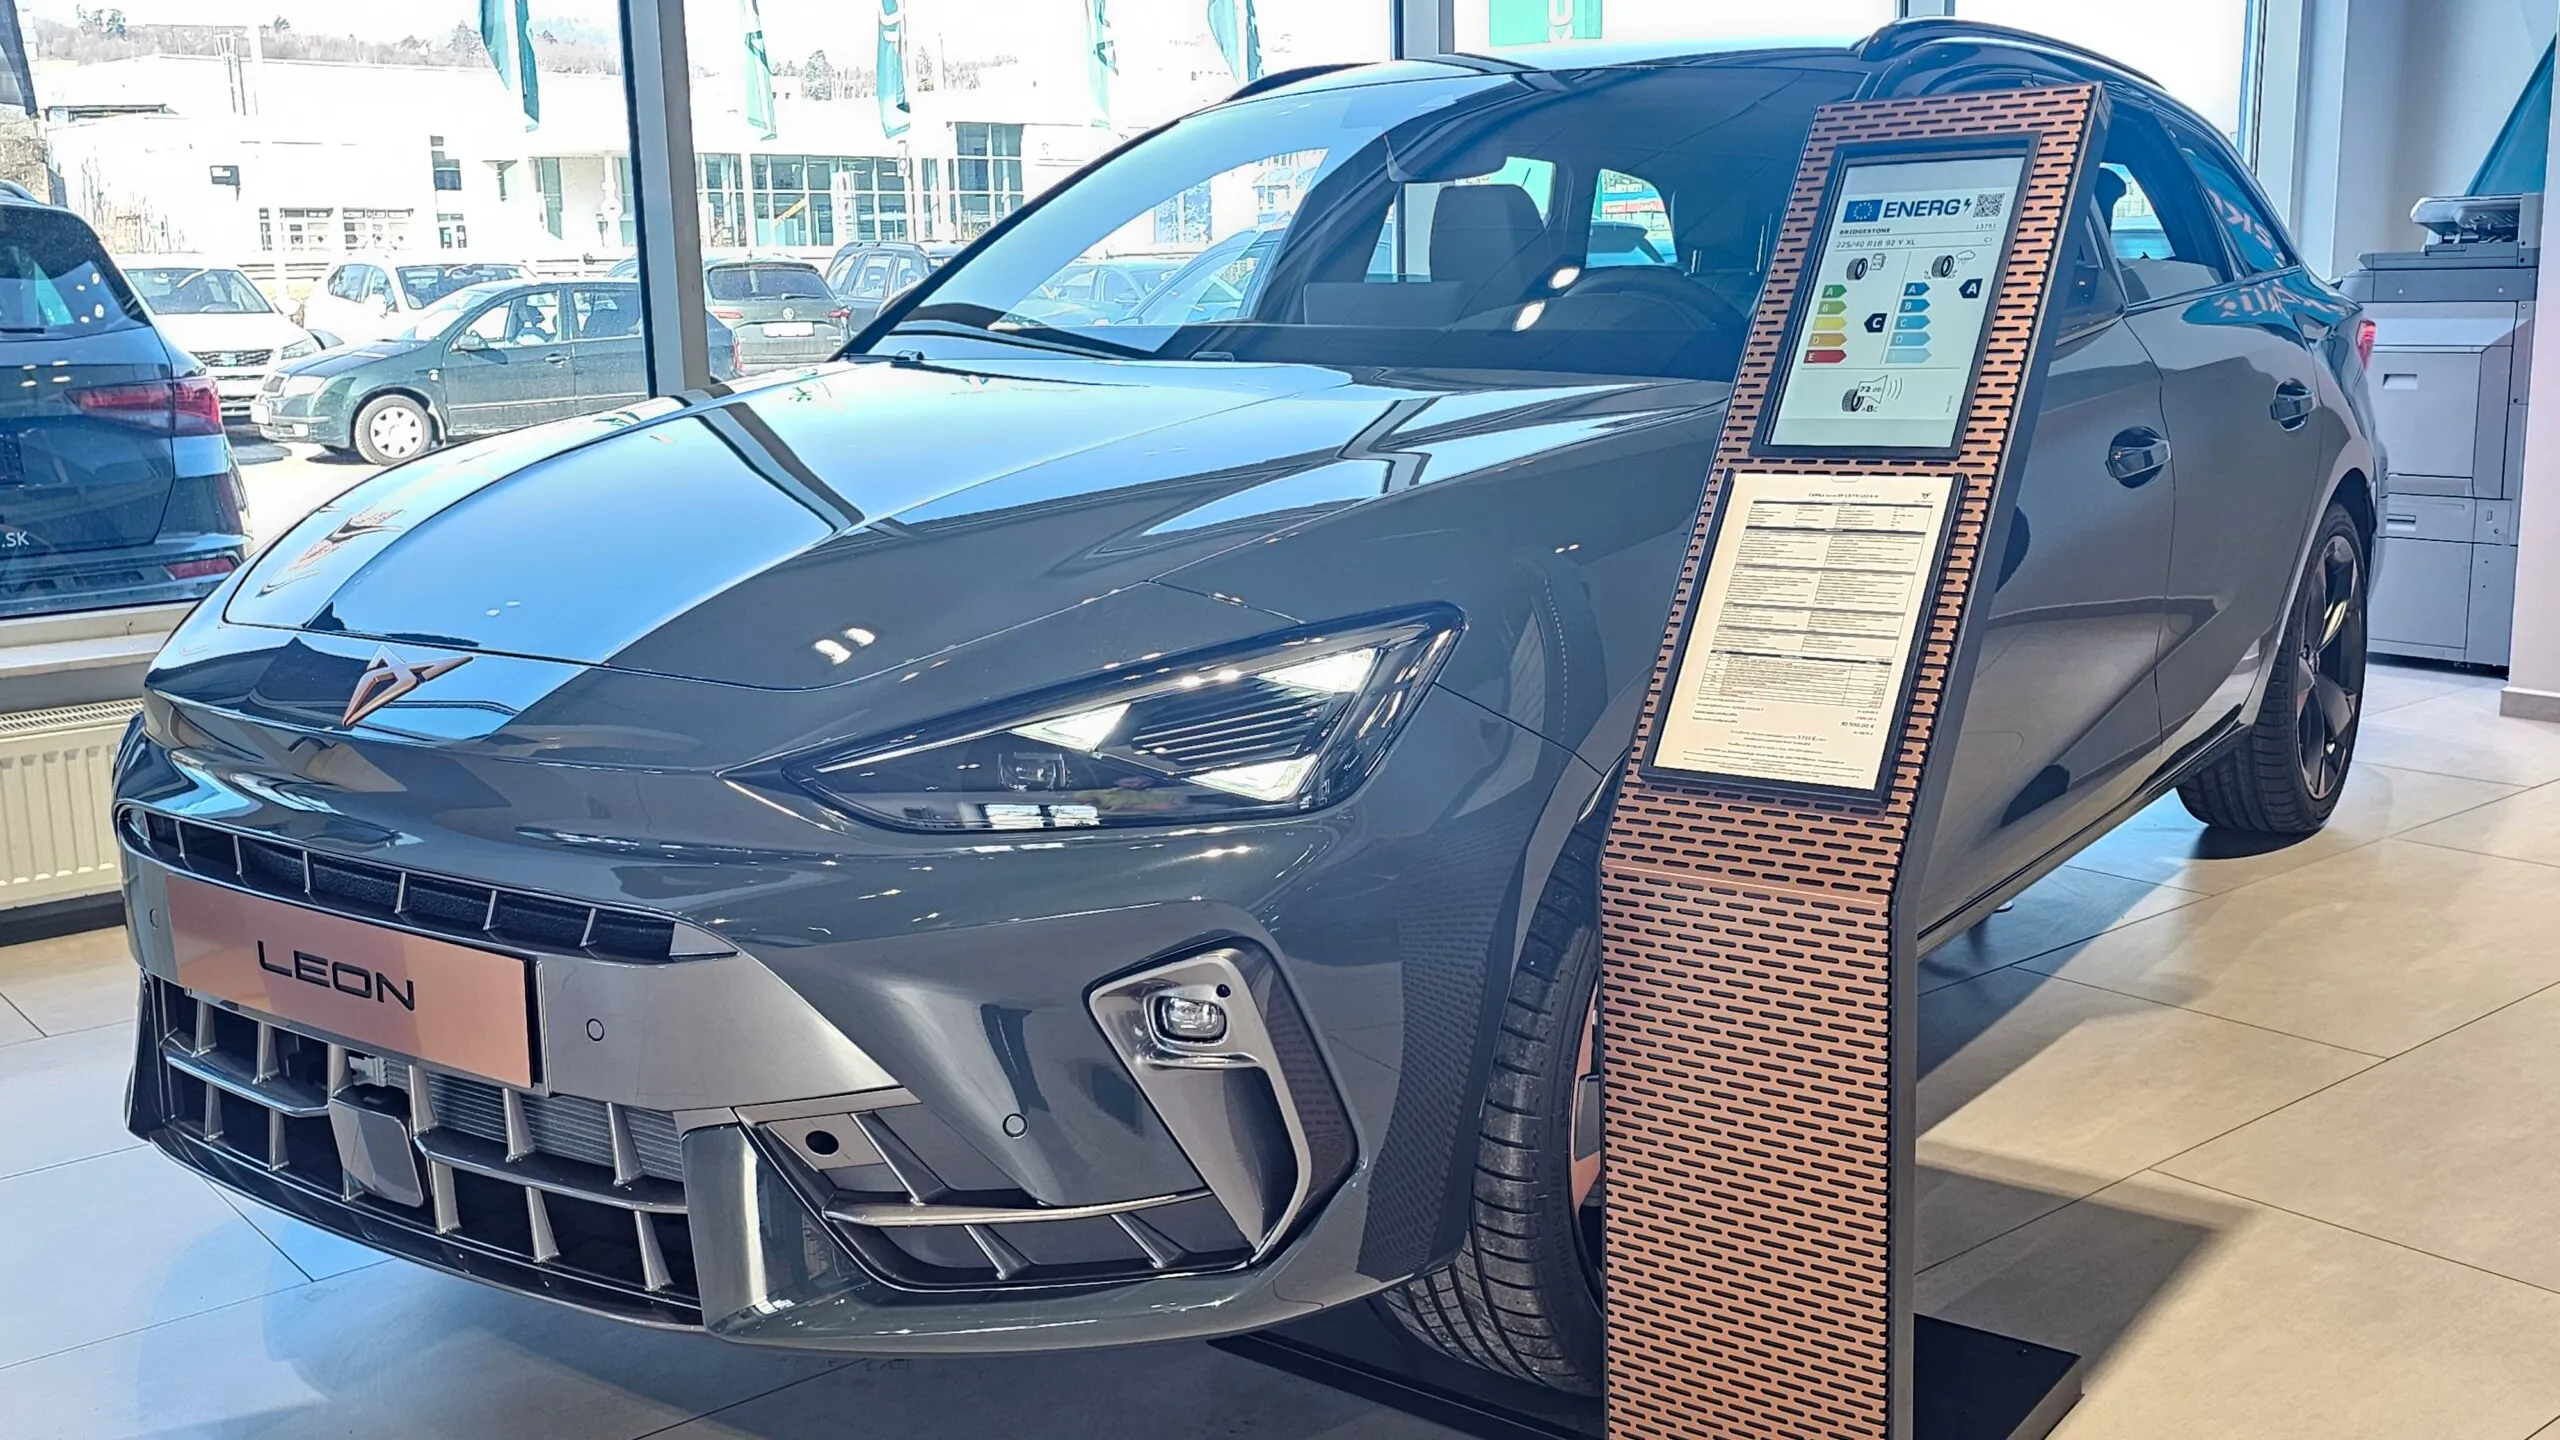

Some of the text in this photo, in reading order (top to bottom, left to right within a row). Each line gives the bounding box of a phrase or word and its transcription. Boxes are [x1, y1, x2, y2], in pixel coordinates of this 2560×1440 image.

[1883, 198, 1961, 218] ENERG
[1839, 227, 1891, 235] BRIDGESTONE
[1836, 239, 1865, 248] 225/40
[1885, 239, 1896, 247] 92
[1905, 238, 1915, 246] XL
[1825, 287, 1833, 296] A
[1907, 286, 1917, 294] A
[1966, 284, 1978, 294] A
[1821, 304, 1829, 312] B
[1904, 302, 1912, 310] B
[1872, 317, 1883, 328] C
[1900, 318, 1908, 327] C
[1812, 336, 1820, 344] D
[1895, 335, 1903, 344] D
[1807, 353, 1815, 362] E
[257, 939, 416, 1012] LEON
